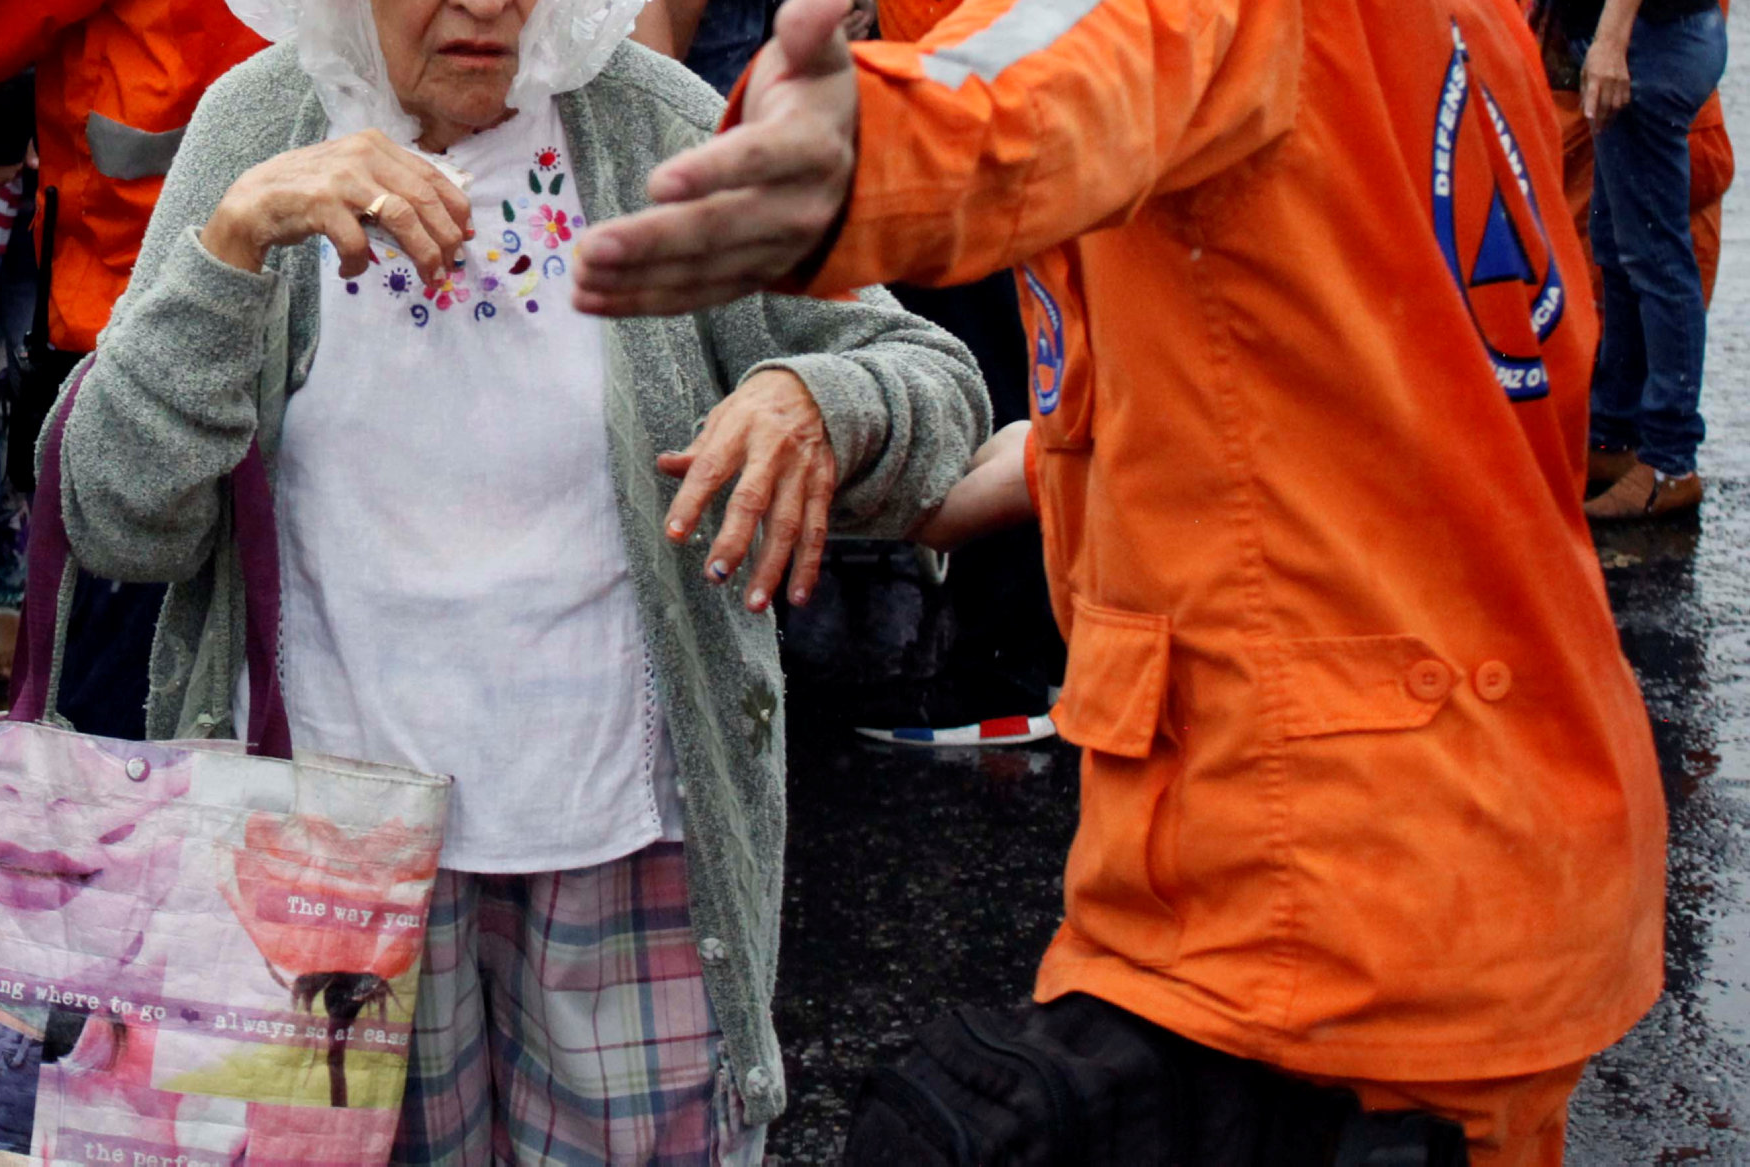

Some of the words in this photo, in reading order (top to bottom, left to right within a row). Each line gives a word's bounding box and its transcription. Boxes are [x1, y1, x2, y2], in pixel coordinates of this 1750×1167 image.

[1434, 49, 1466, 196] DEFENS
[287, 896, 326, 917] The
[333, 905, 374, 927] way
[383, 912, 421, 928] you
[36, 985, 100, 1010] where
[110, 996, 132, 1015] to
[139, 1004, 168, 1022] go
[214, 1012, 297, 1039] always
[305, 1025, 327, 1040] so
[363, 1027, 410, 1046] ease
[84, 1142, 124, 1163] the
